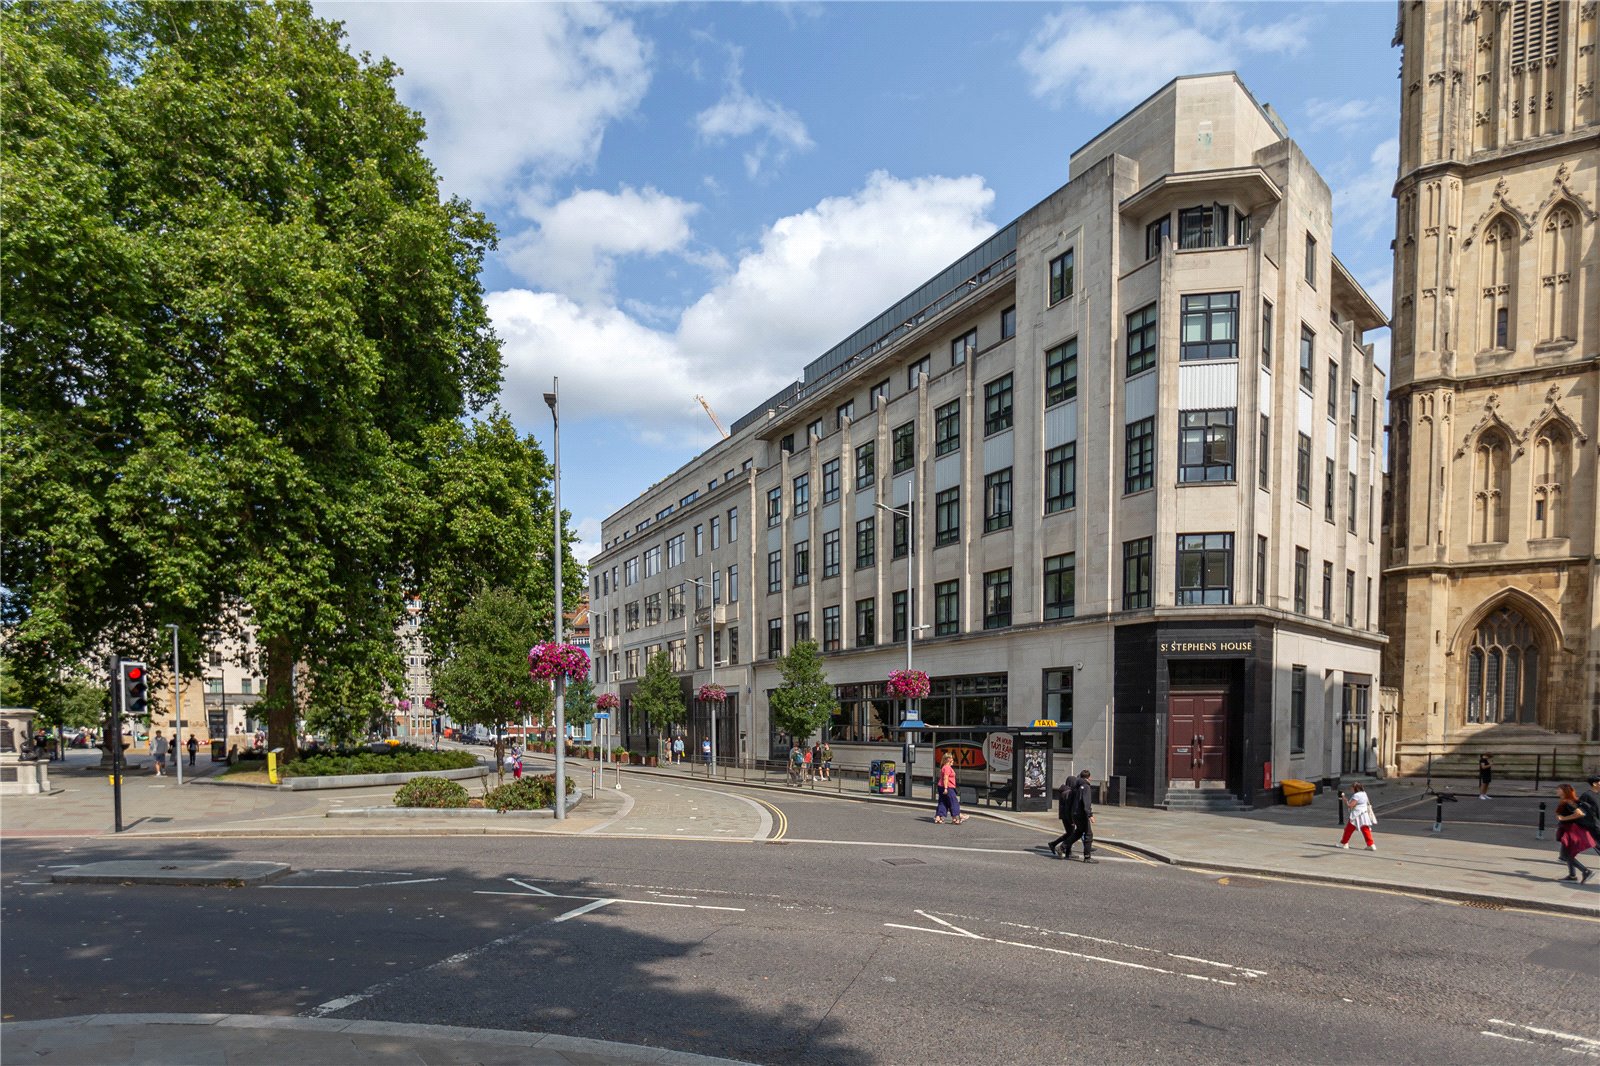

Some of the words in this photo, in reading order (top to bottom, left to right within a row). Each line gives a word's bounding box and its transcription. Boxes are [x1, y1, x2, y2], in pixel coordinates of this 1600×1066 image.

[1220, 641, 1252, 651] HOUSE
[1037, 719, 1054, 727] TAXI
[991, 741, 1001, 750] TAXI
[1002, 737, 1012, 745] HOUR
[994, 750, 1011, 761] HERE!
